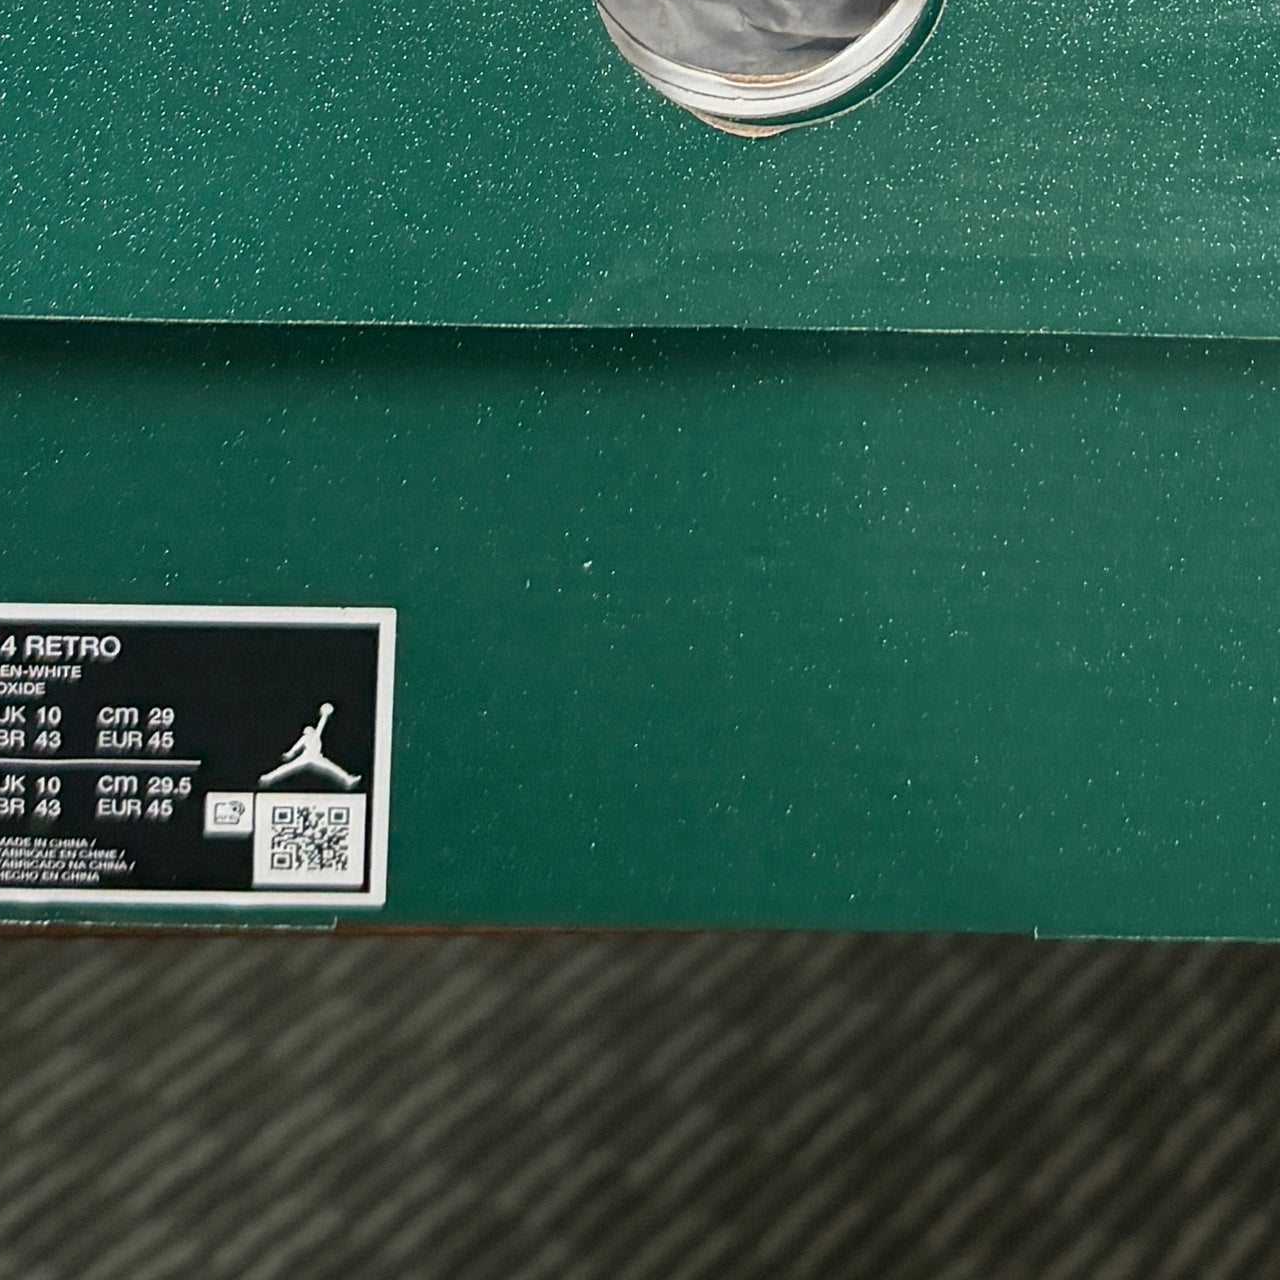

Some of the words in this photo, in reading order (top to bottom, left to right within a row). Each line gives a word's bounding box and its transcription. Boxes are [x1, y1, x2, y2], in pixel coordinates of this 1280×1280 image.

[0, 635, 17, 657] 4
[24, 635, 121, 658] RETRO
[37, 706, 62, 724] 10
[148, 708, 175, 725] 29
[35, 730, 62, 747] 43
[98, 731, 143, 747] EUR
[147, 731, 174, 747] 45
[36, 776, 62, 793] 10
[148, 776, 192, 794] 29.5
[34, 798, 61, 815] 43
[98, 799, 142, 816] EUR
[146, 799, 173, 816] 45
